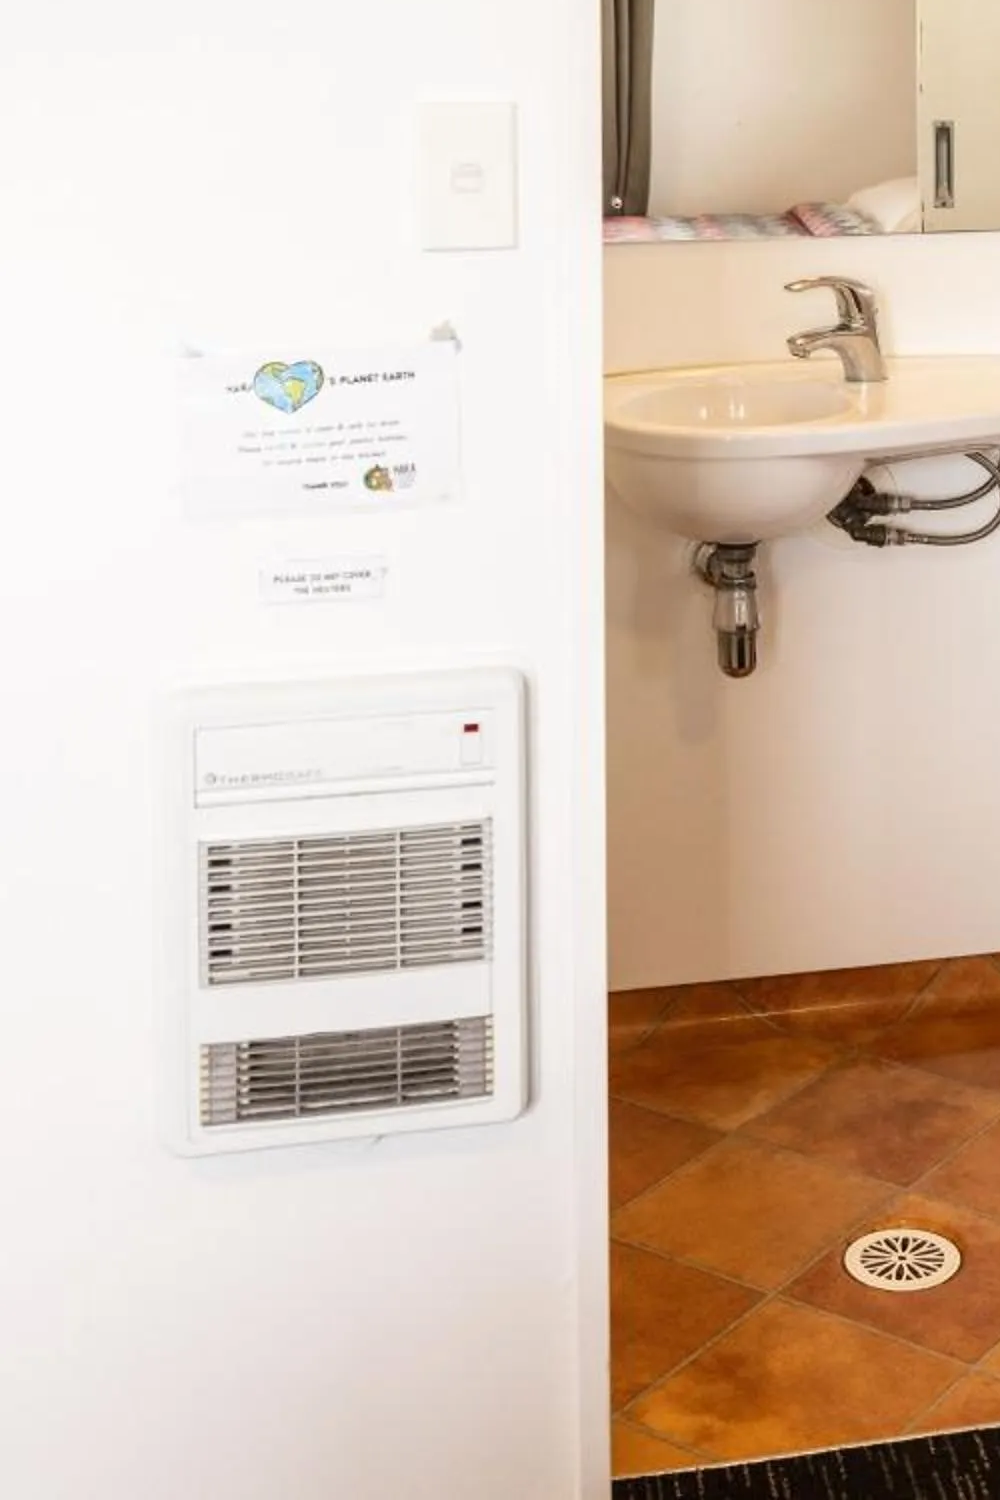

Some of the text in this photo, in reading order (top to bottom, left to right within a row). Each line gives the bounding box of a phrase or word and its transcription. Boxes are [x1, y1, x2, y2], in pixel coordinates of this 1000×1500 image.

[339, 373, 380, 385] PLANET
[382, 371, 416, 382] EARTH
[273, 573, 306, 584] PLEASE
